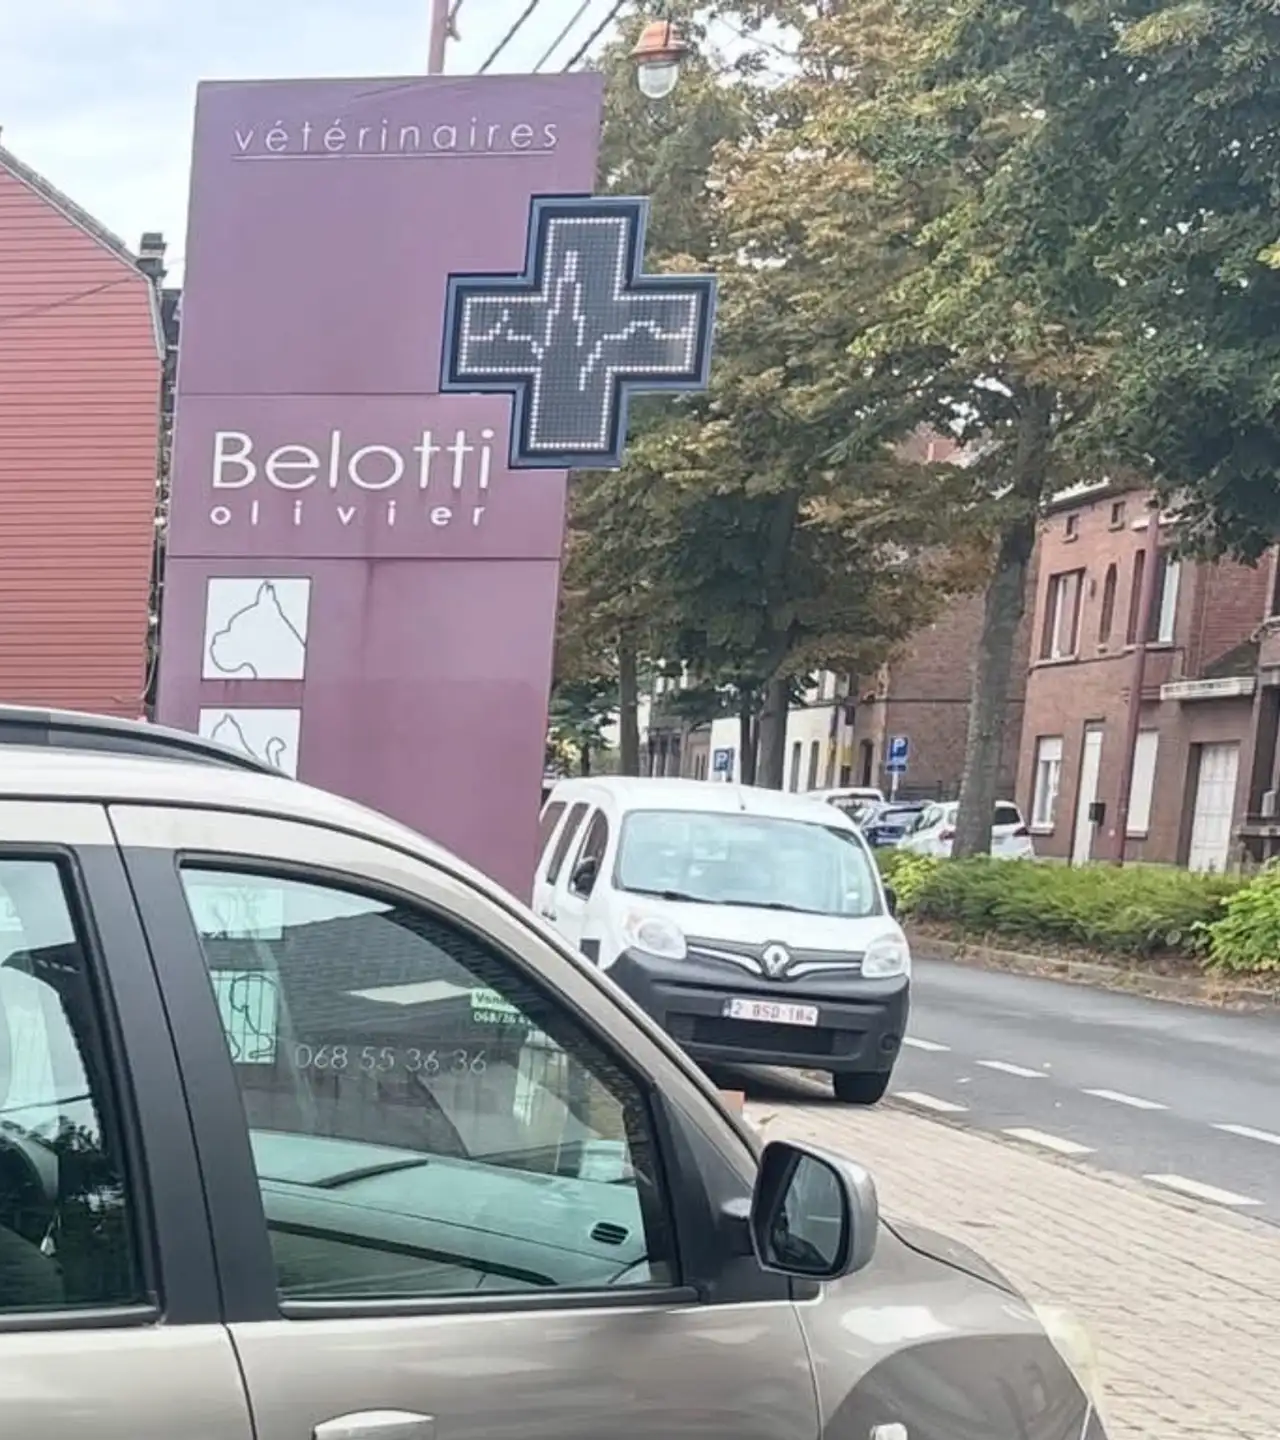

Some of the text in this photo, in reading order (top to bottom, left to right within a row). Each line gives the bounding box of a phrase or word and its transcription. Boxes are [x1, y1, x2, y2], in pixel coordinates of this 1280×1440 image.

[233, 117, 558, 151] vétérinaires
[212, 429, 494, 489] Belotti
[210, 500, 485, 526] olivier
[294, 1044, 487, 1075] 068 55 36 36
